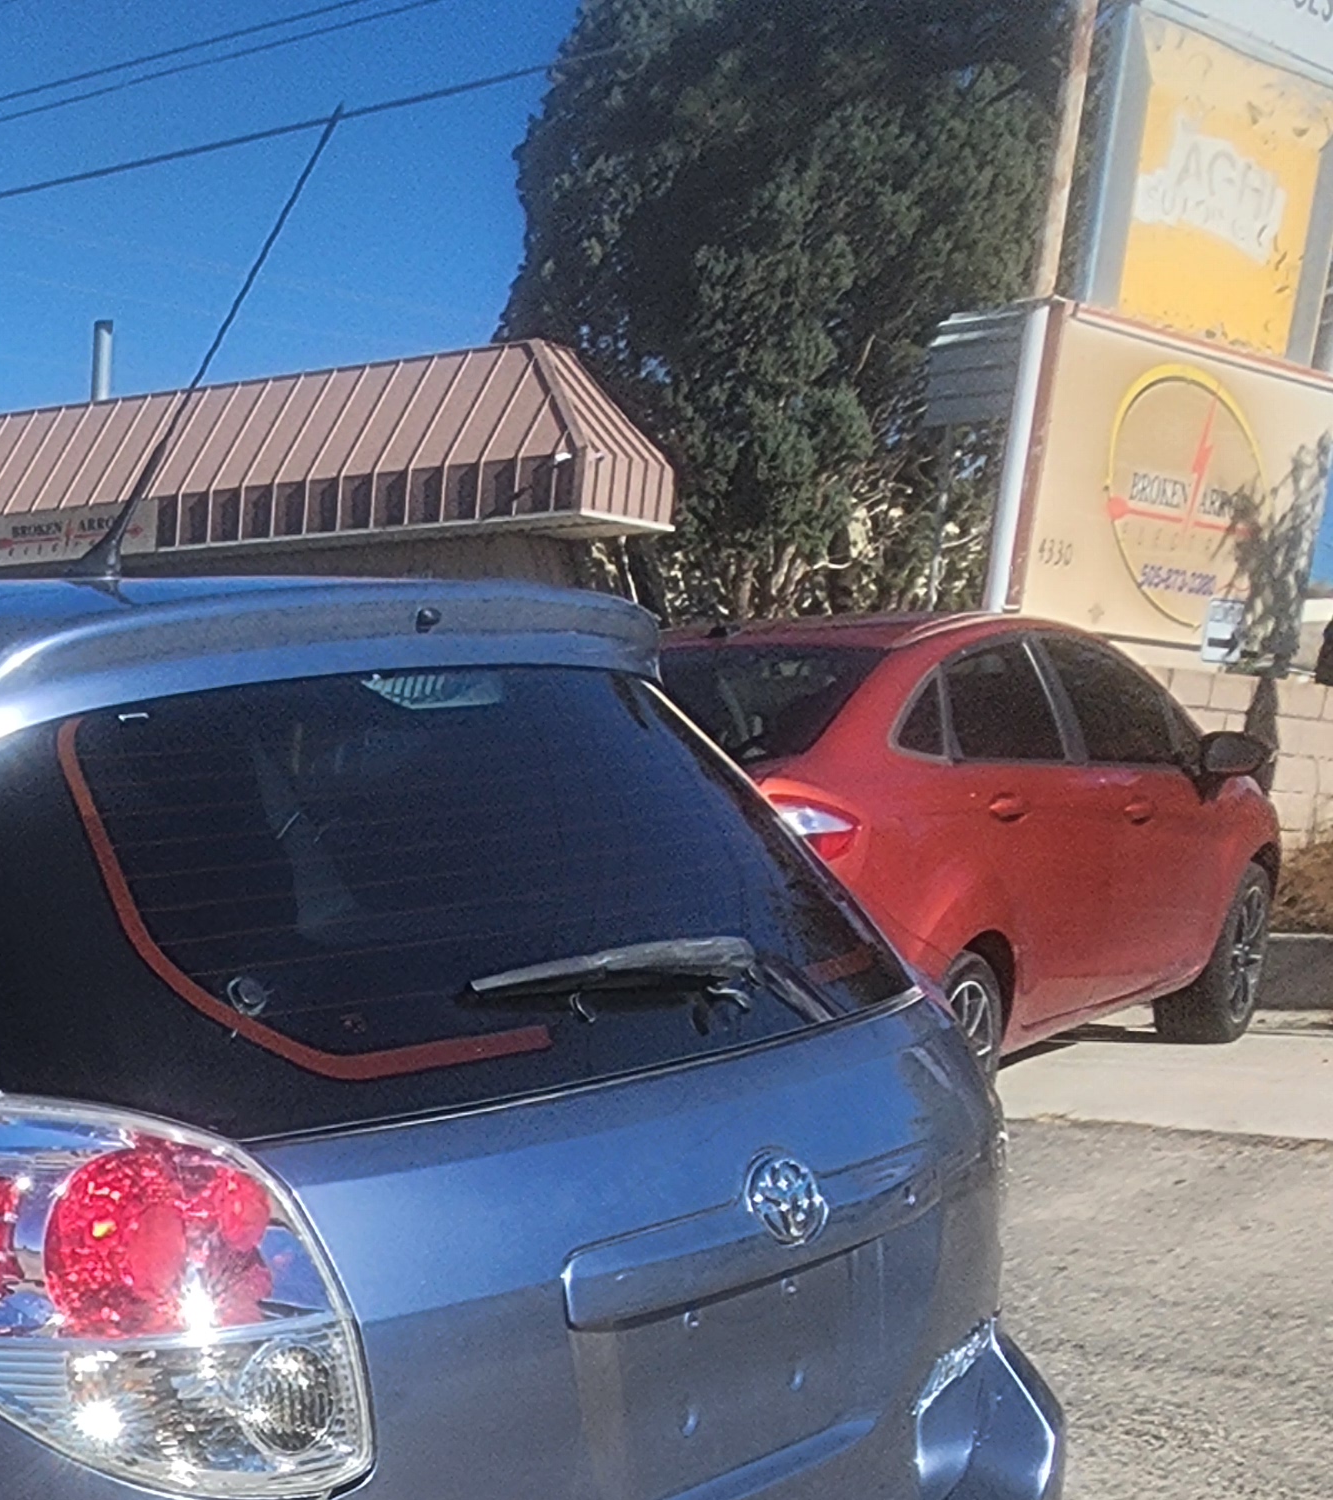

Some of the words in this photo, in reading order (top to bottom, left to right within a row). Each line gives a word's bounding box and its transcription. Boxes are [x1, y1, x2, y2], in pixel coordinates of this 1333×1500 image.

[1129, 471, 1190, 509] BROKEN
[11, 520, 63, 539] BROKEN
[77, 515, 117, 532] ARRO
[1038, 537, 1074, 567] 4330
